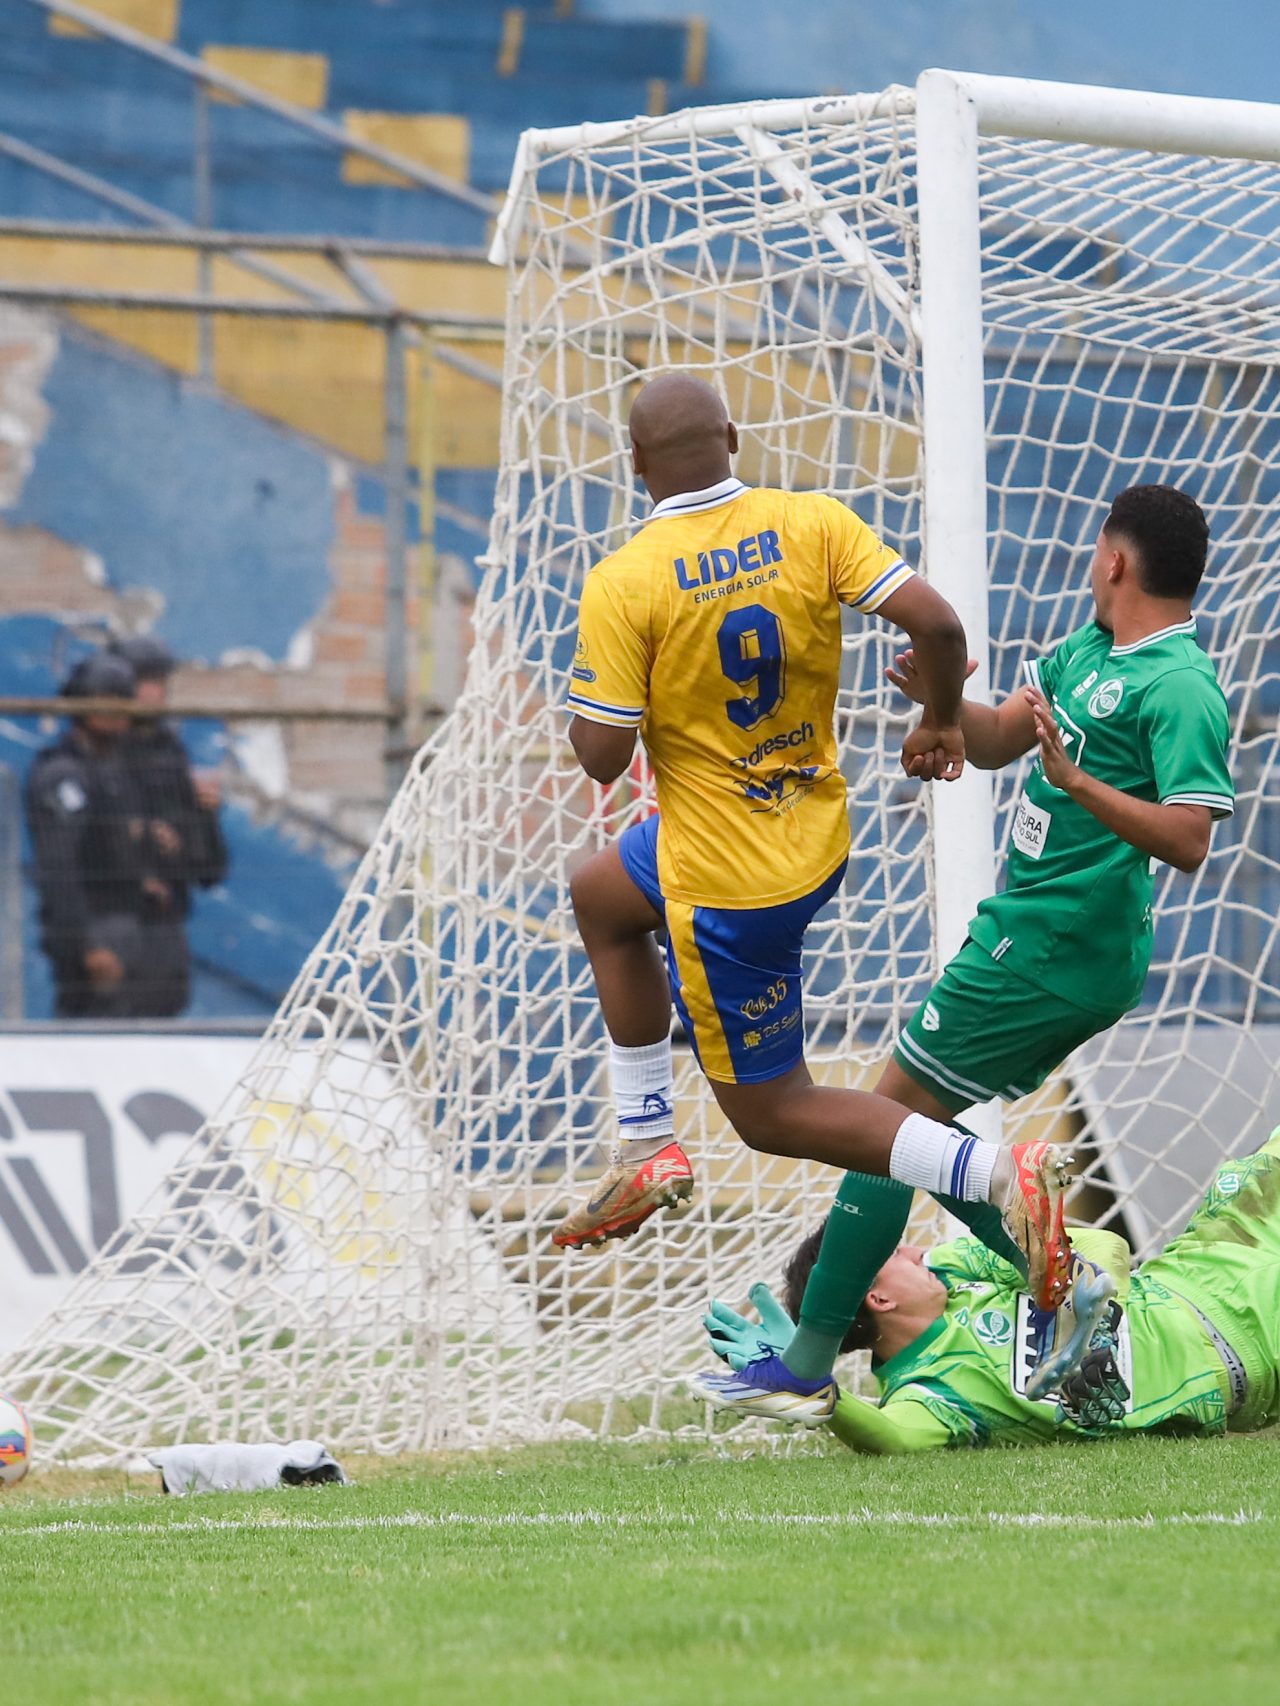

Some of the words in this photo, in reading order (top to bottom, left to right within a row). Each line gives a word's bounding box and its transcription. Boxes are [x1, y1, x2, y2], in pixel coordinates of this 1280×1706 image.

[674, 529, 784, 591] LÍDER
[694, 582, 744, 604] ENERGIA
[747, 569, 779, 589] SOLAR
[716, 603, 787, 732] 9
[767, 976, 787, 1009] 35
